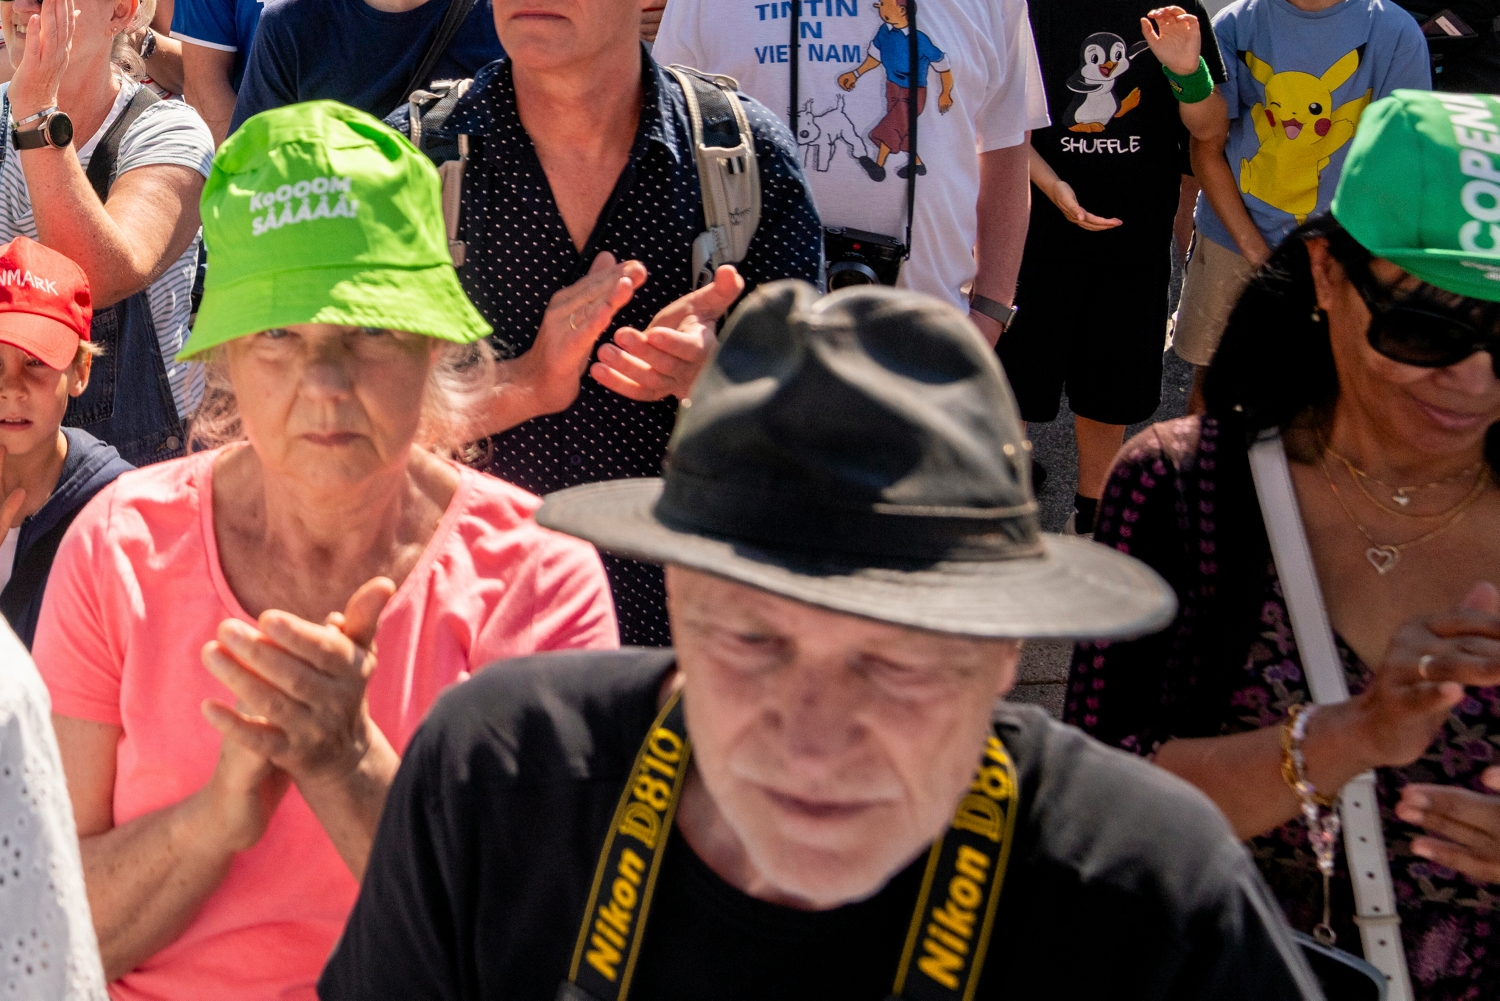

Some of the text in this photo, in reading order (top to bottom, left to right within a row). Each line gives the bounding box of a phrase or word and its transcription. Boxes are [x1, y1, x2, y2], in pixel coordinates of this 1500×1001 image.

[808, 43, 862, 63] NAM
[1060, 135, 1141, 154] SHUFFLE
[585, 727, 684, 983] Nikon D810
[917, 844, 991, 990] Nikon
